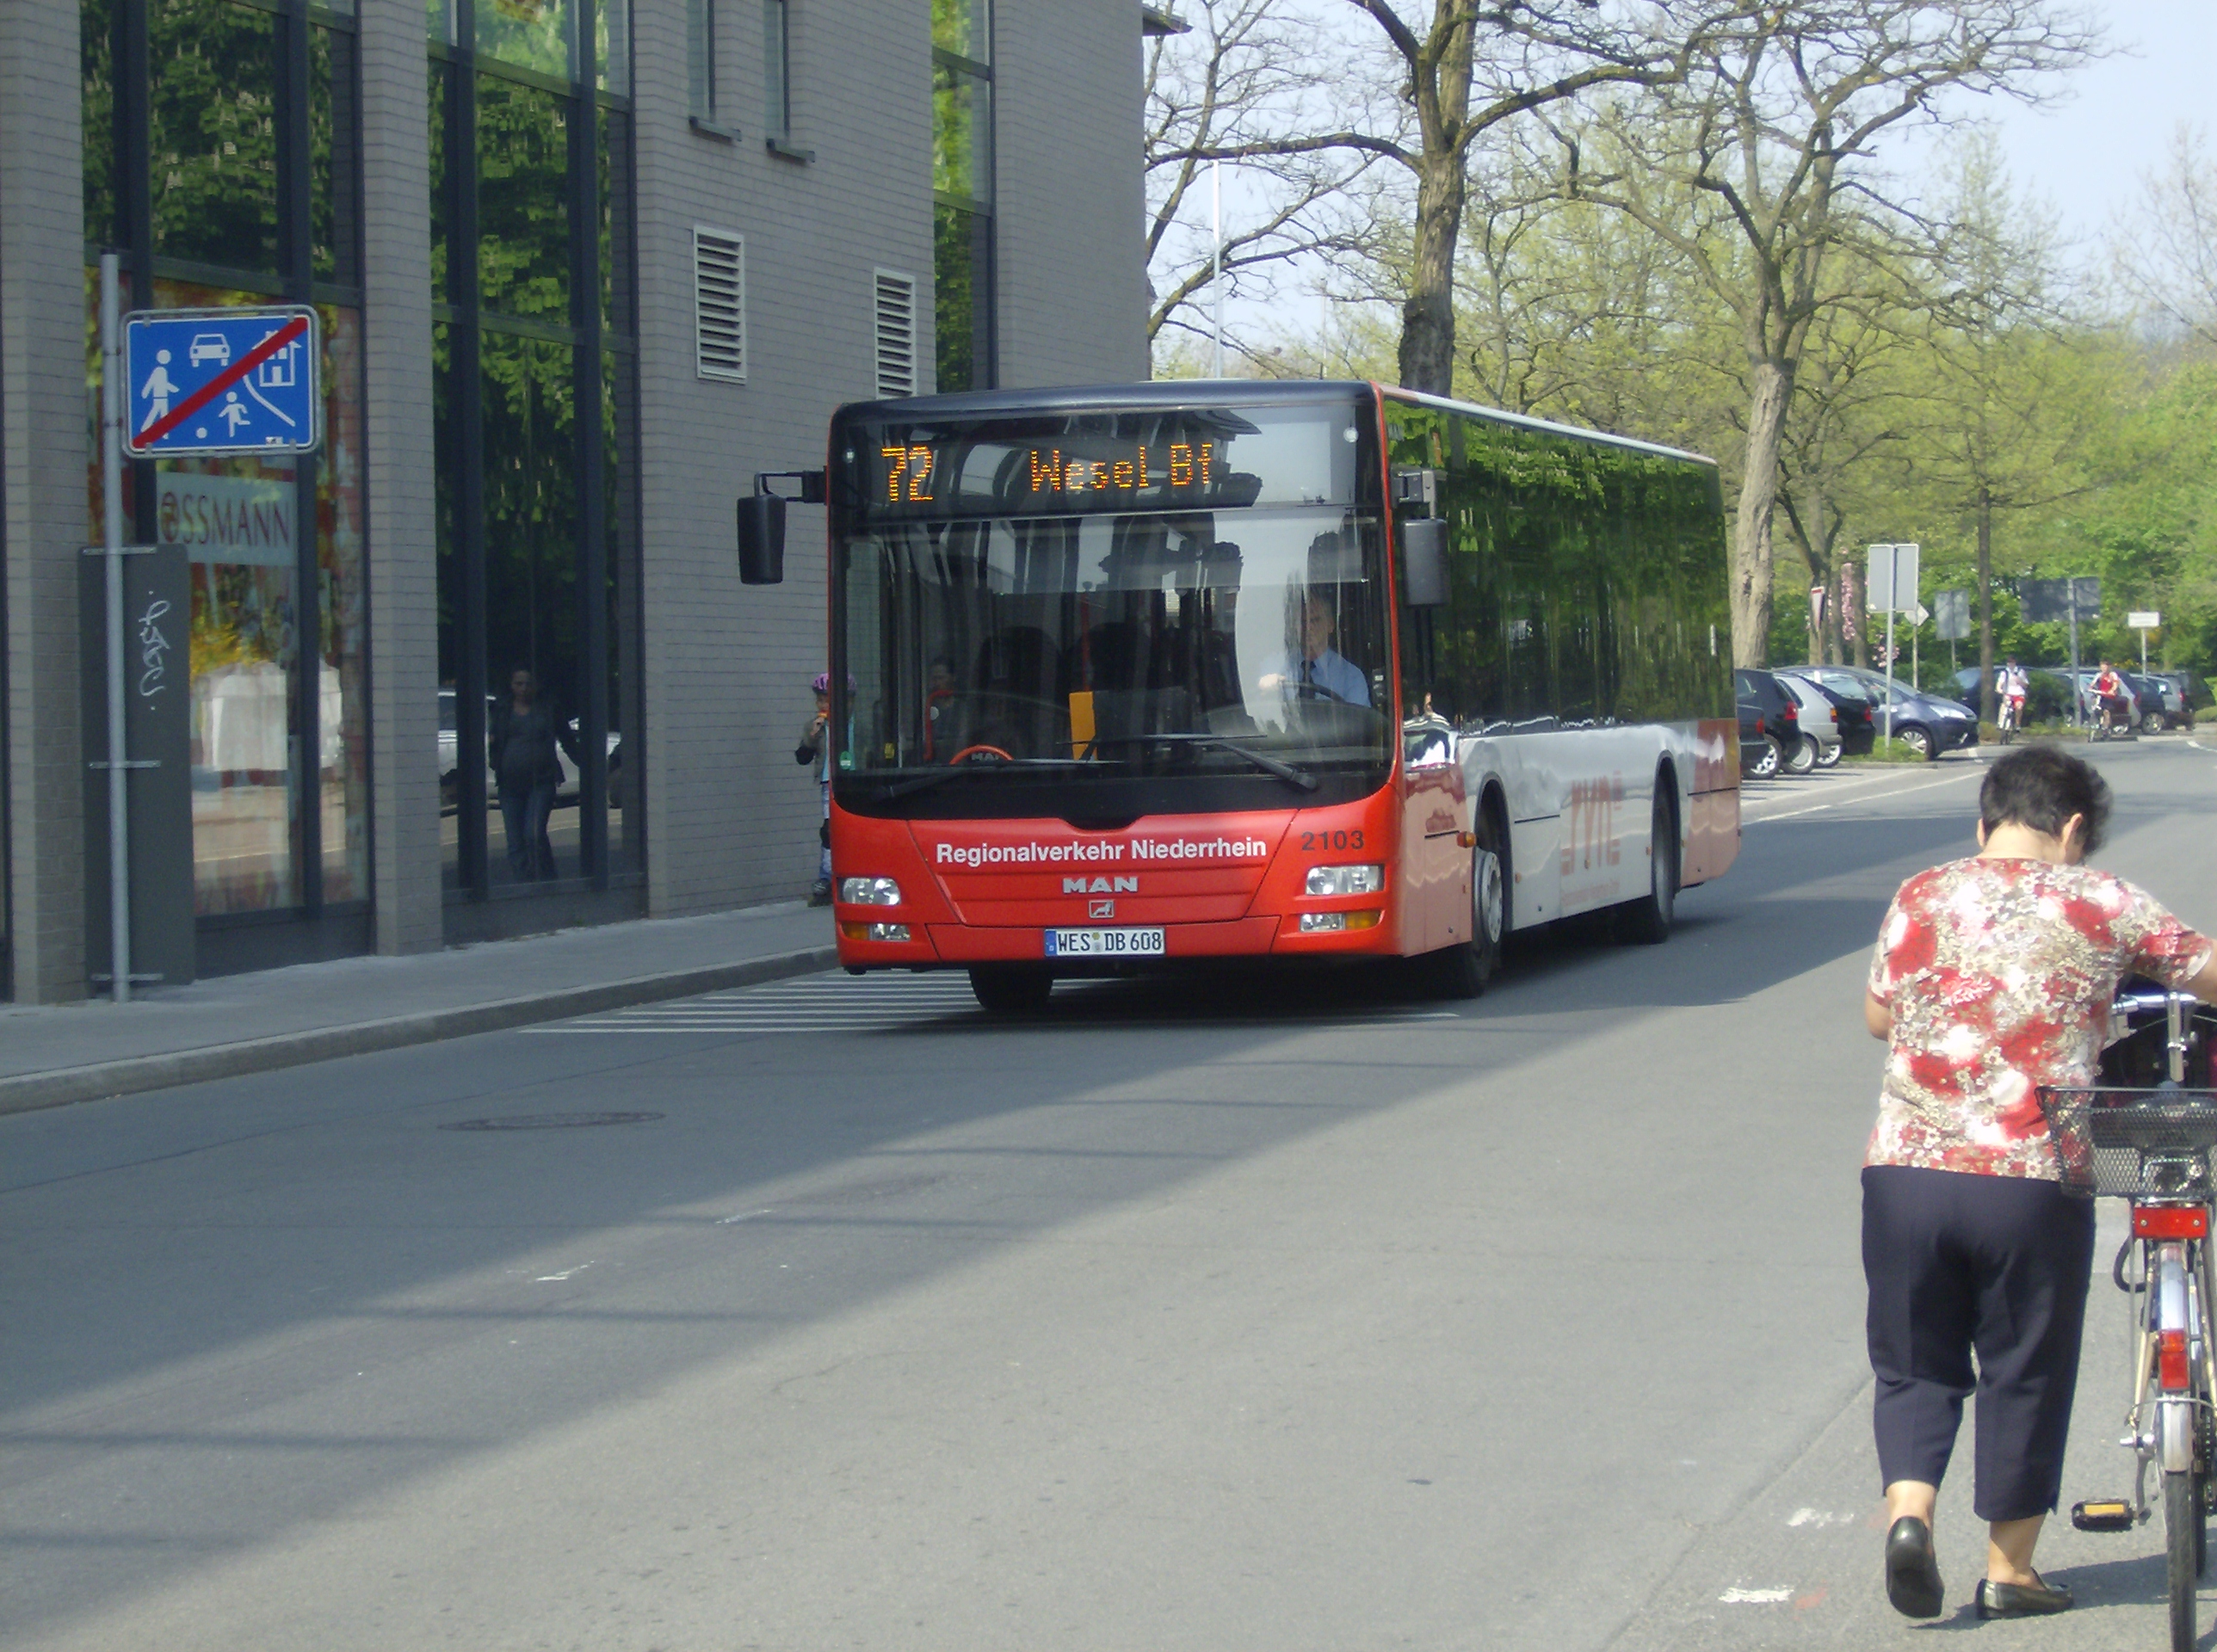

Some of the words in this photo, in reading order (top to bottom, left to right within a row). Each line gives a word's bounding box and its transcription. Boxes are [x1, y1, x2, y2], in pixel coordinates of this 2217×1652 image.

[881, 446, 934, 501] 72
[1031, 447, 1149, 490] Wesel
[1170, 443, 1212, 485] Bf
[160, 491, 289, 546] OSSMANN
[936, 840, 1125, 867] Regionalverkehr
[1131, 836, 1267, 860] Niederrhein
[1300, 829, 1364, 851] 2103
[1062, 876, 1138, 893] MAN
[1058, 934, 1090, 952] WES
[1104, 933, 1126, 952] DB
[1130, 932, 1162, 952] 608
